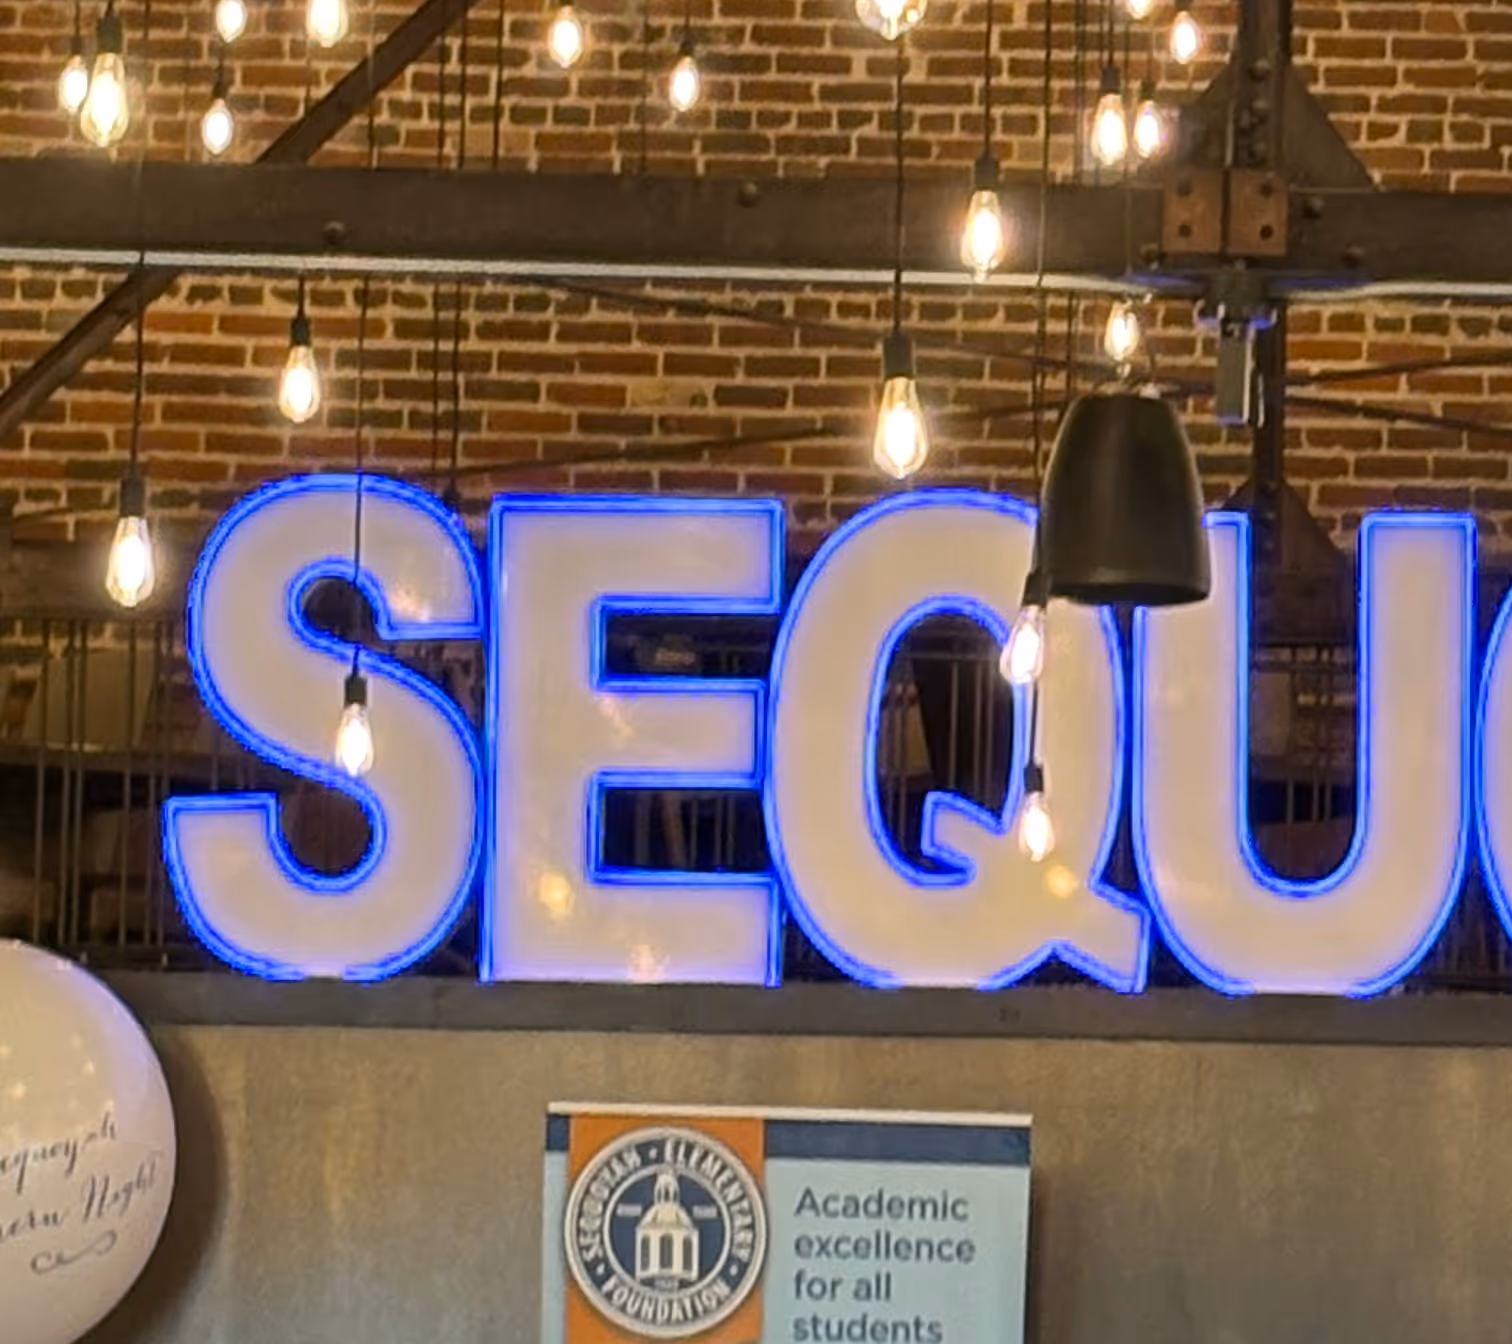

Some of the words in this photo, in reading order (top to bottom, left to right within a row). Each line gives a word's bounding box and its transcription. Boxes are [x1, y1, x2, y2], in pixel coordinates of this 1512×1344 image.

[664, 1137, 754, 1262] ELEMENTARY
[793, 1186, 970, 1222] Academic
[793, 1229, 976, 1264] excellence
[601, 1273, 732, 1325] FOUNDATION
[793, 1268, 844, 1302] for
[852, 1270, 892, 1302] all
